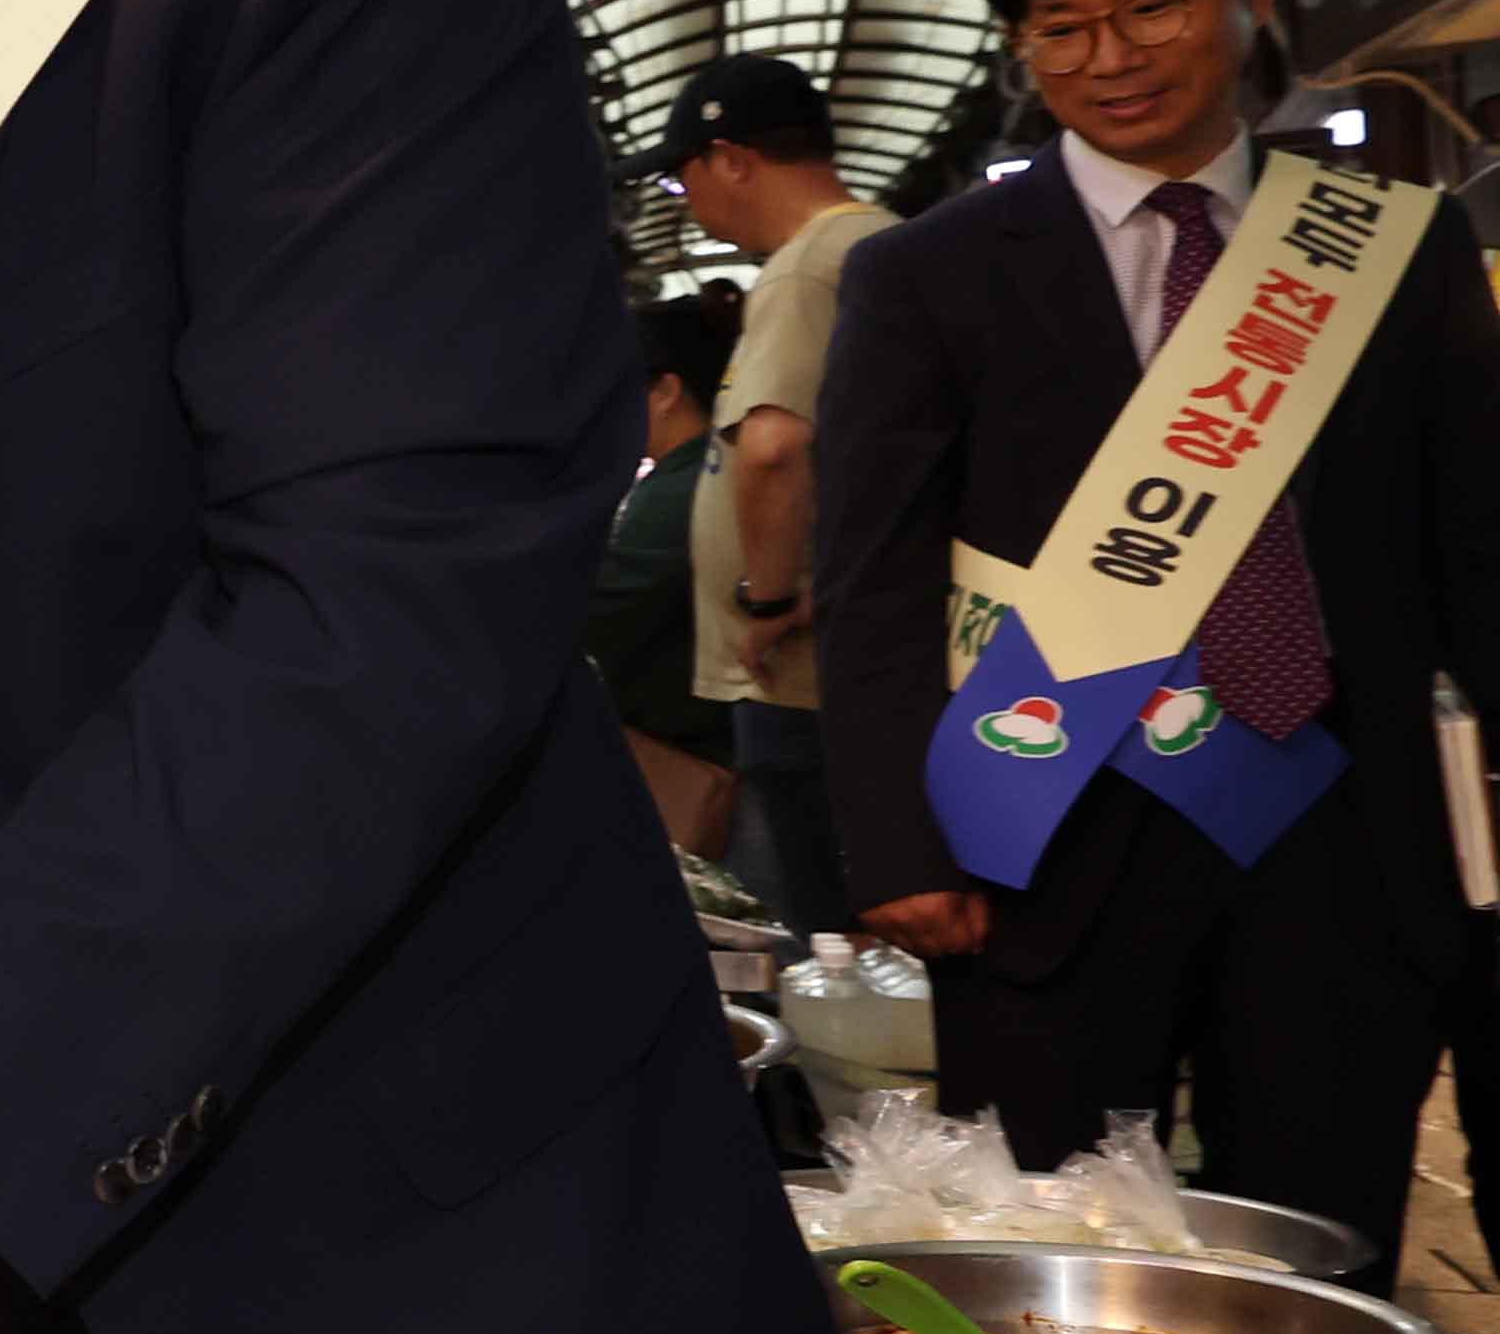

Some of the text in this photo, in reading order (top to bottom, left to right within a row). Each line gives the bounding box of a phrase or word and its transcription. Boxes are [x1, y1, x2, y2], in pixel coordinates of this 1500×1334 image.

[1281, 181, 1384, 273] 모두
[1162, 267, 1338, 469] 전통시장
[1089, 476, 1218, 587] 이용
